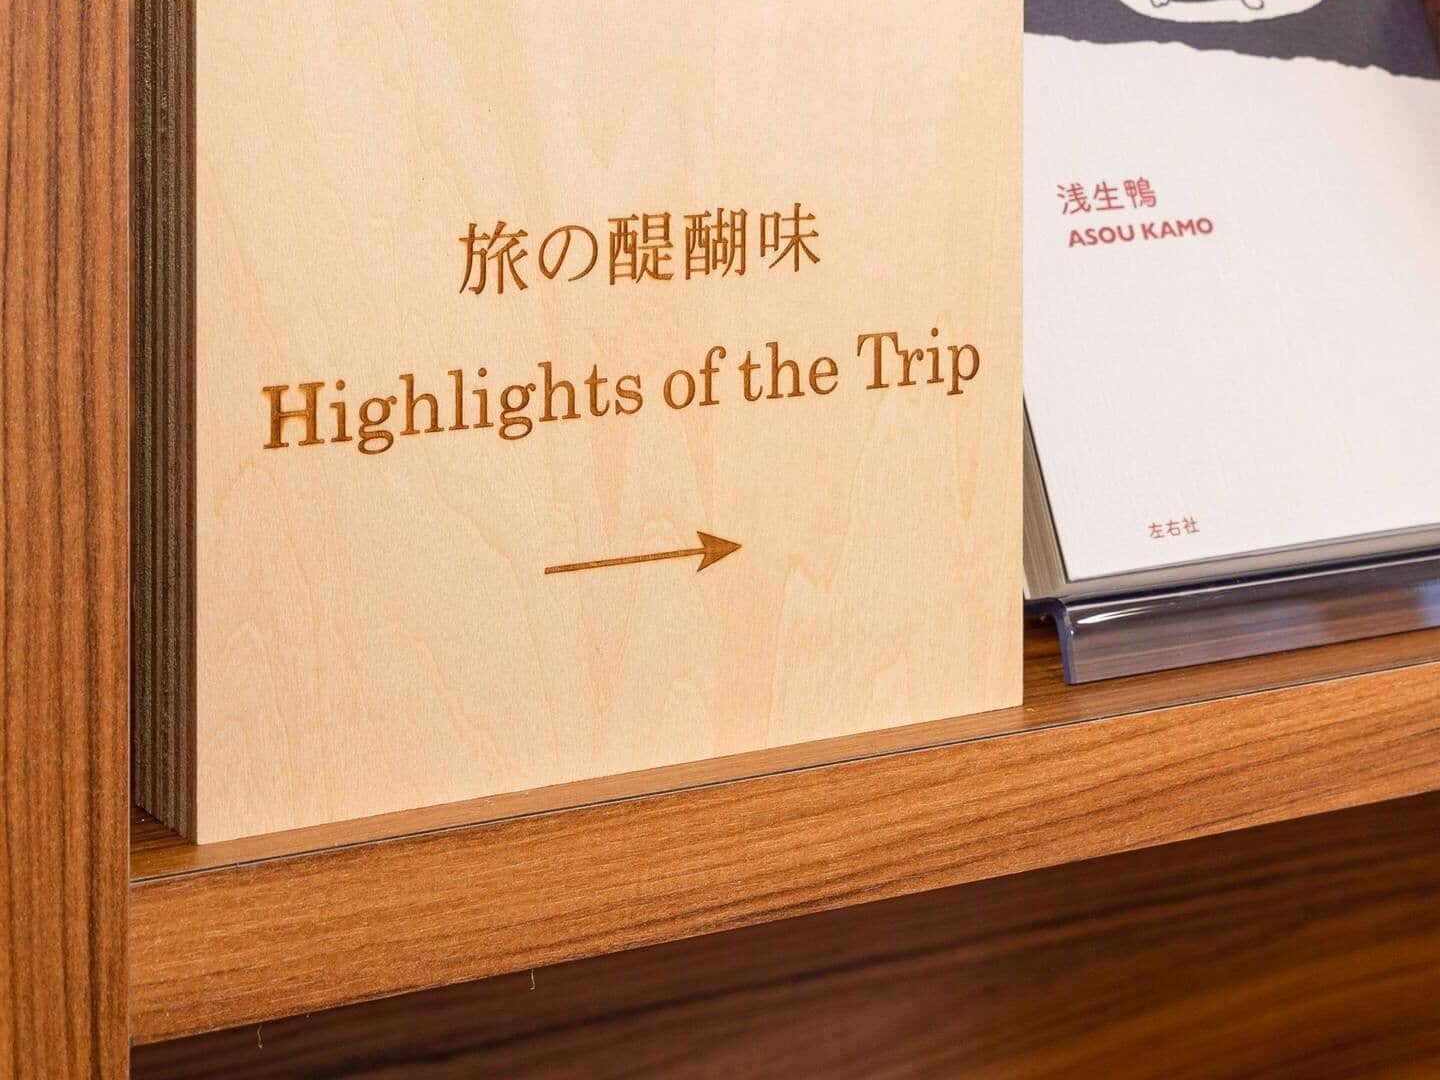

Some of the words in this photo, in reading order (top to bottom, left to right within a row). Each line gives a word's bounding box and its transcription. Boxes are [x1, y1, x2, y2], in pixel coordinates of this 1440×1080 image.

[1056, 176, 1158, 215] 浅生鴨
[458, 202, 822, 297] 旅の醍醐味
[1068, 223, 1136, 247] ASOU
[1141, 218, 1214, 240] KAMO
[261, 361, 645, 455] Highlights
[661, 346, 727, 411] of
[737, 341, 840, 404] the
[856, 327, 981, 400] Trip
[1147, 515, 1200, 539] 左右社
